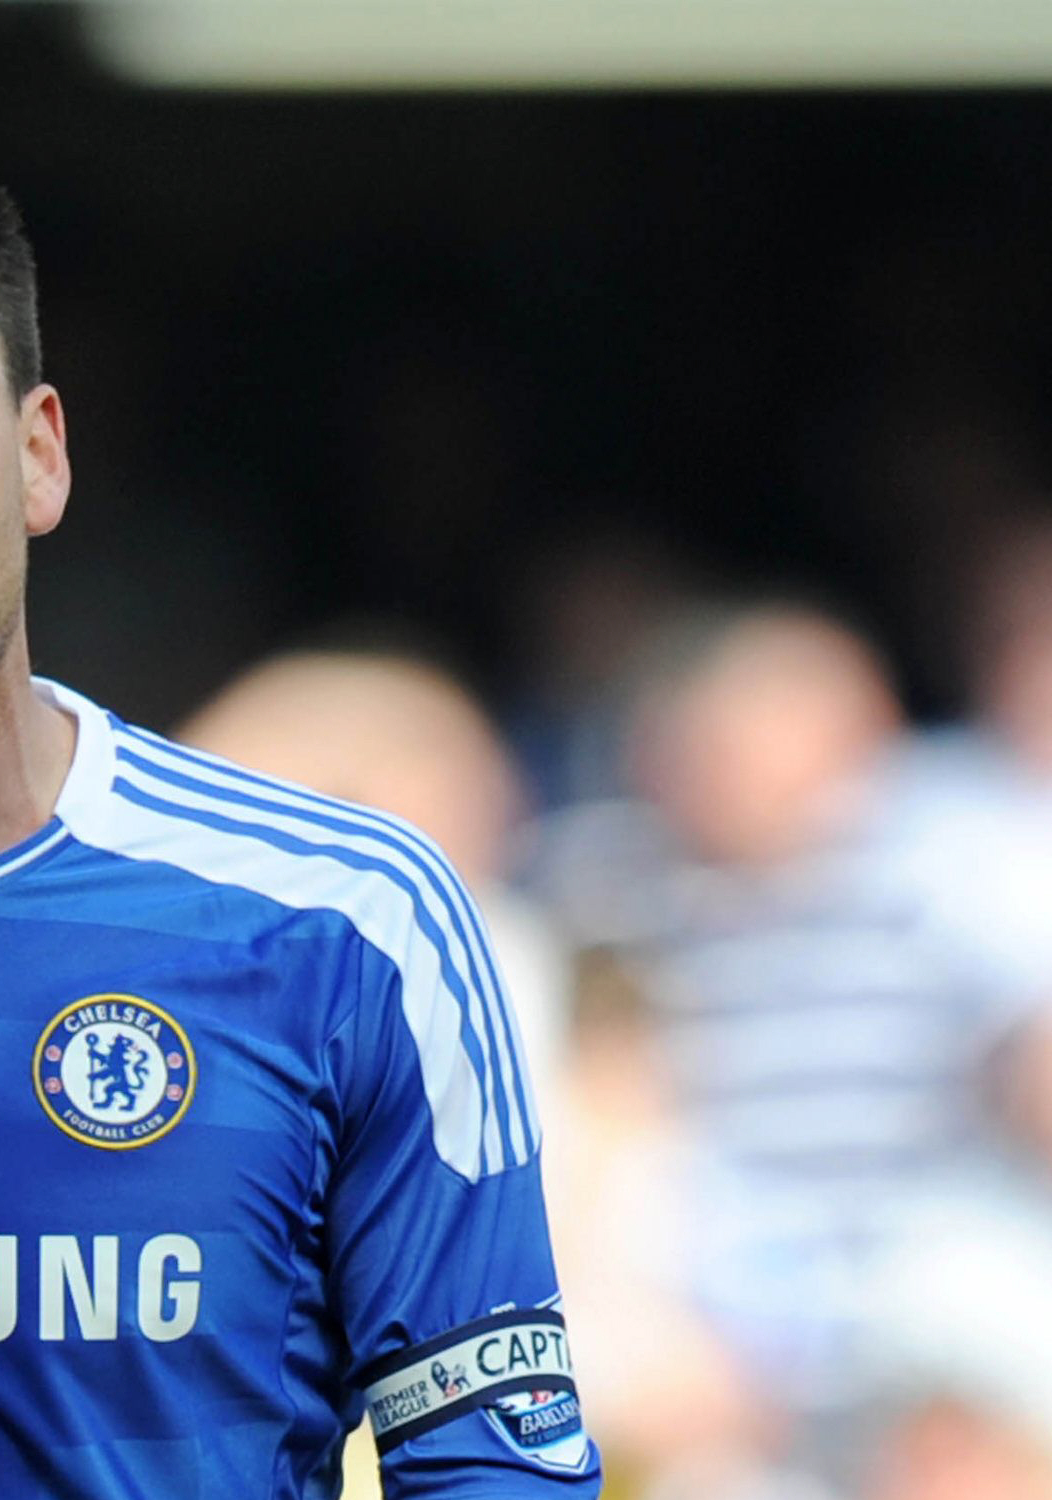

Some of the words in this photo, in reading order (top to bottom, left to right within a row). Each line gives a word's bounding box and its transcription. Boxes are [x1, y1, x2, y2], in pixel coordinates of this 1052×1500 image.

[64, 1004, 162, 1040] CHELSEA
[63, 1109, 127, 1139] FOOTBALL
[132, 1113, 165, 1136] CLUB
[378, 1395, 430, 1428] LEAGUE
